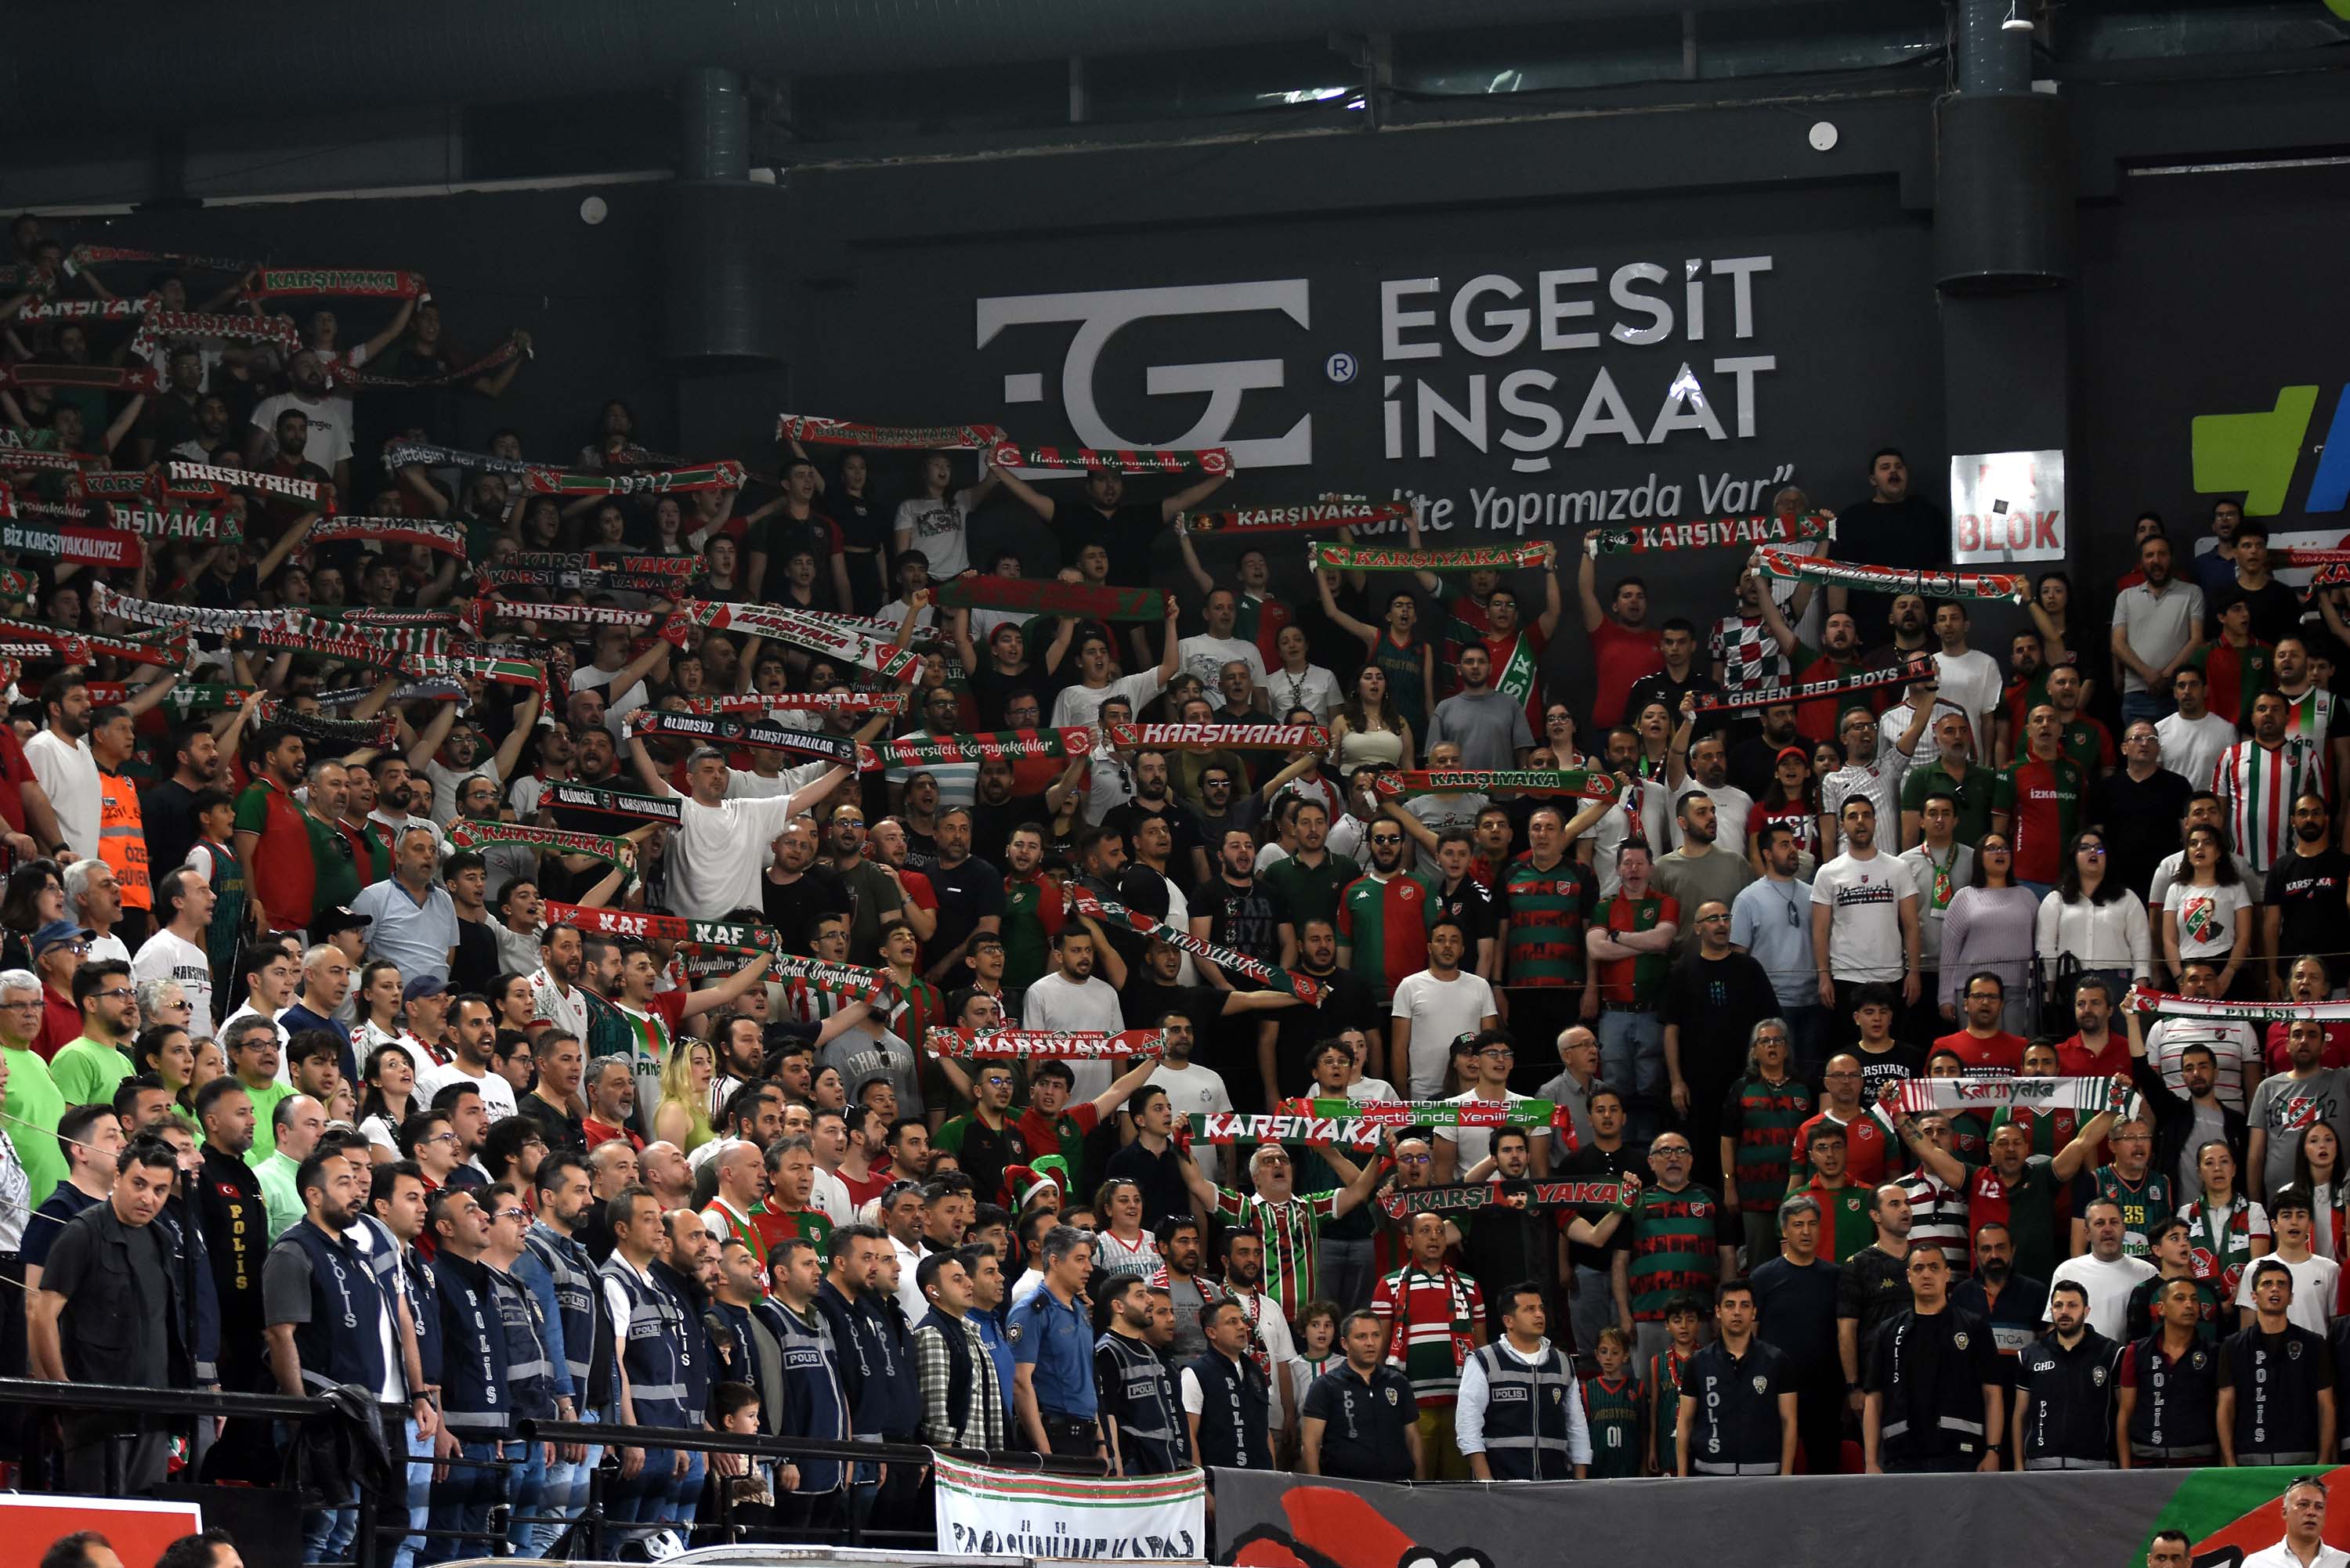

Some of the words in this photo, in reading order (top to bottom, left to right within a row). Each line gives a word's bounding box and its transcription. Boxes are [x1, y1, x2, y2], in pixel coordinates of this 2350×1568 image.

[265, 271, 398, 293] KARŞIYAKA
[1383, 361, 1777, 473] İNŞAAT
[1237, 504, 1374, 527] KARŞIYAKA
[1958, 509, 2060, 551] BLOK
[3, 523, 22, 546] BİZ
[26, 529, 123, 561] KARŞIYAKALIYIZ!
[1641, 517, 1787, 547] KARŞIYAKA
[1728, 685, 1792, 706] GREEN
[1802, 678, 1839, 696] RED
[1849, 666, 1900, 688] BOYS
[662, 714, 716, 734] ÖLÜMSÜZ
[749, 727, 834, 754] KARŞIYAKALILAR
[883, 740, 958, 762] Üniversiteli
[960, 737, 1053, 761] Karşıyakalılar
[1142, 723, 1307, 748] KARŞIYAKA
[1429, 771, 1561, 790] KARŞIYAKA
[559, 788, 597, 807] ÖLÜMSÜZ
[617, 796, 680, 819] KARŞIYAKALILAR
[598, 912, 649, 938] KAF
[696, 923, 746, 945] KAF
[688, 954, 736, 973] Hayaller
[2263, 1006, 2297, 1019] KSK
[1204, 1114, 1382, 1145] KARŞIYAKA
[1408, 1185, 1494, 1213] KARŞI
[1535, 1182, 1618, 1204] YAKA
[1979, 1179, 2001, 1198] 12
[2124, 1205, 2144, 1224] 35
[2034, 1360, 2056, 1372] GHD
[2151, 1355, 2165, 1445] POLİS
[2254, 1349, 2269, 1443] POLİS
[1225, 1376, 1248, 1466] POLİS
